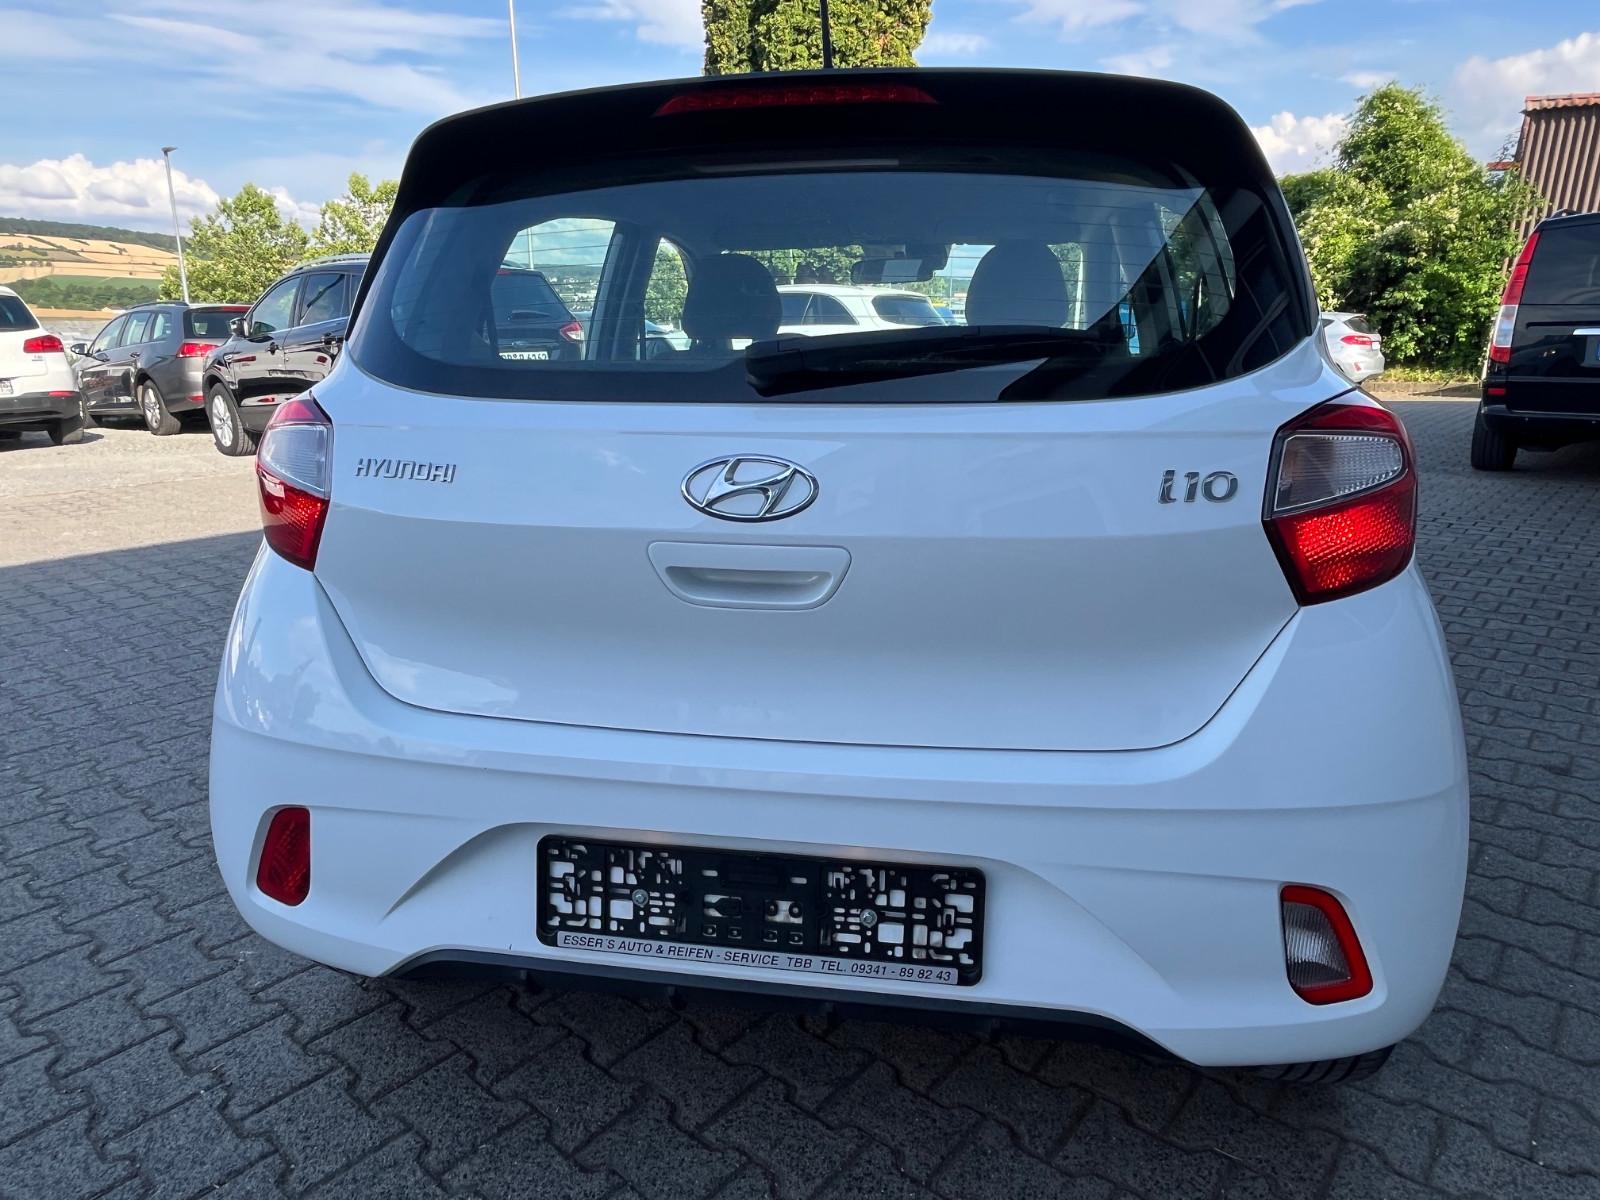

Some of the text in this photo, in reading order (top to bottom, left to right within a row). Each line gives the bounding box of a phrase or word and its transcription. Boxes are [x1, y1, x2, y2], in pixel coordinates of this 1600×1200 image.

[355, 458, 457, 483] HYUNDAI
[1158, 469, 1239, 504] i10
[618, 940, 653, 953] AUTO
[655, 944, 665, 955] &
[667, 945, 714, 960] REIFEN
[723, 951, 779, 967] SERVICE
[786, 956, 813, 969] TBB
[820, 959, 847, 973] TEL.
[850, 963, 887, 976] 09341
[899, 967, 915, 979] 89
[917, 969, 932, 980] 82
[935, 970, 952, 982] 43
